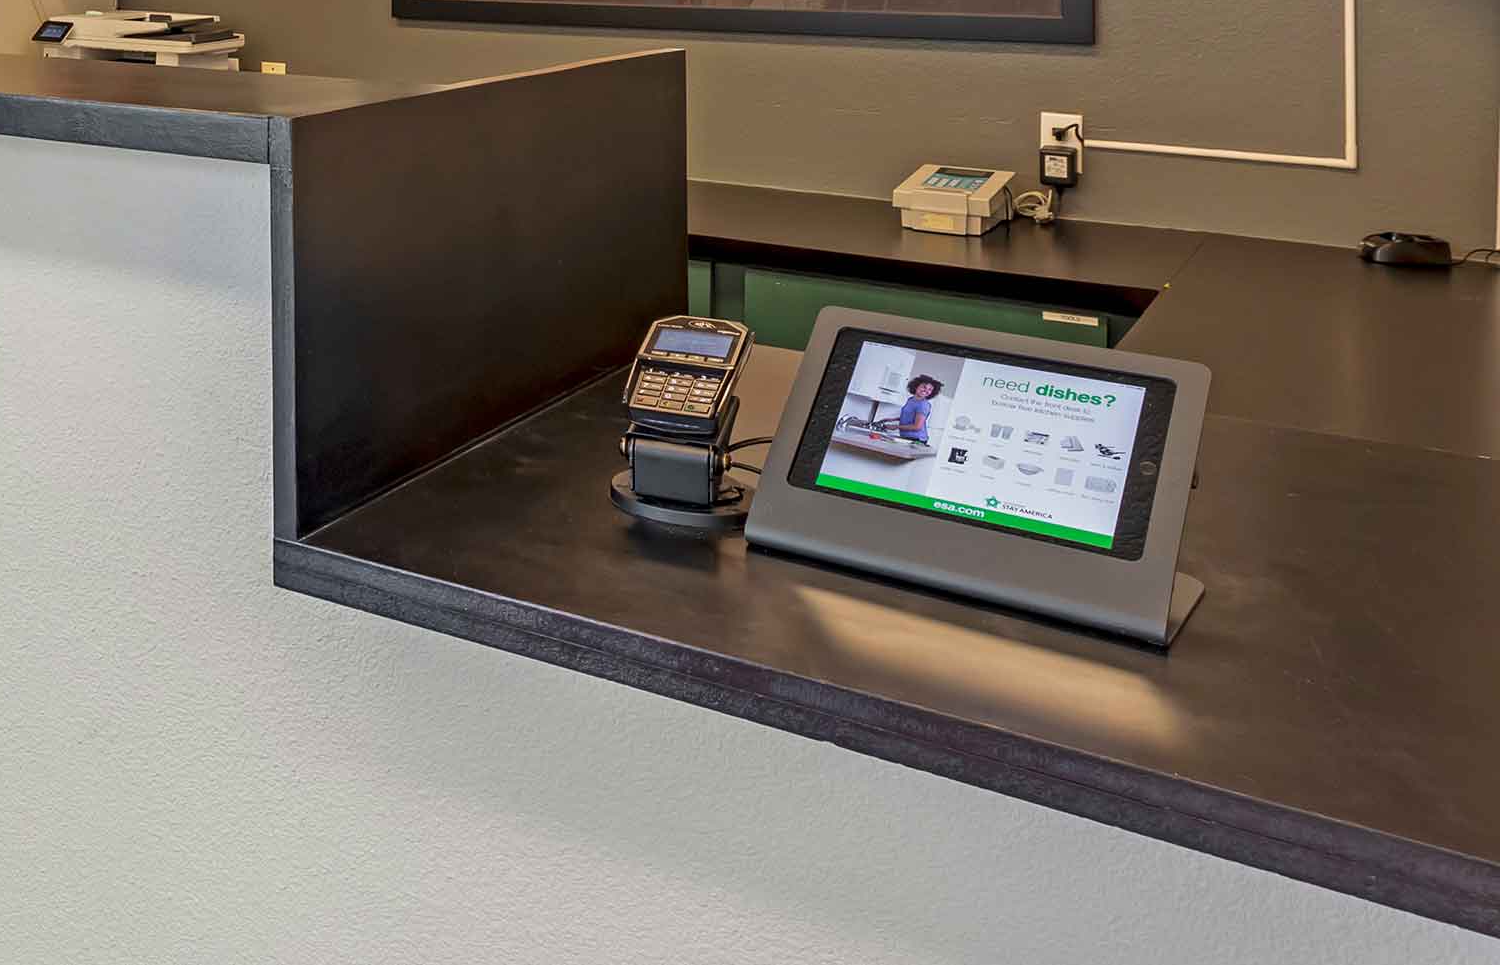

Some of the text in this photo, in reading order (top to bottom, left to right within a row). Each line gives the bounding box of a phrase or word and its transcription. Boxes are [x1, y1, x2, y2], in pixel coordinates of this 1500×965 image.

[982, 376, 1116, 407] need dishes?
[933, 500, 985, 518] esa.com
[1002, 504, 1053, 519] STAY AMERICA
